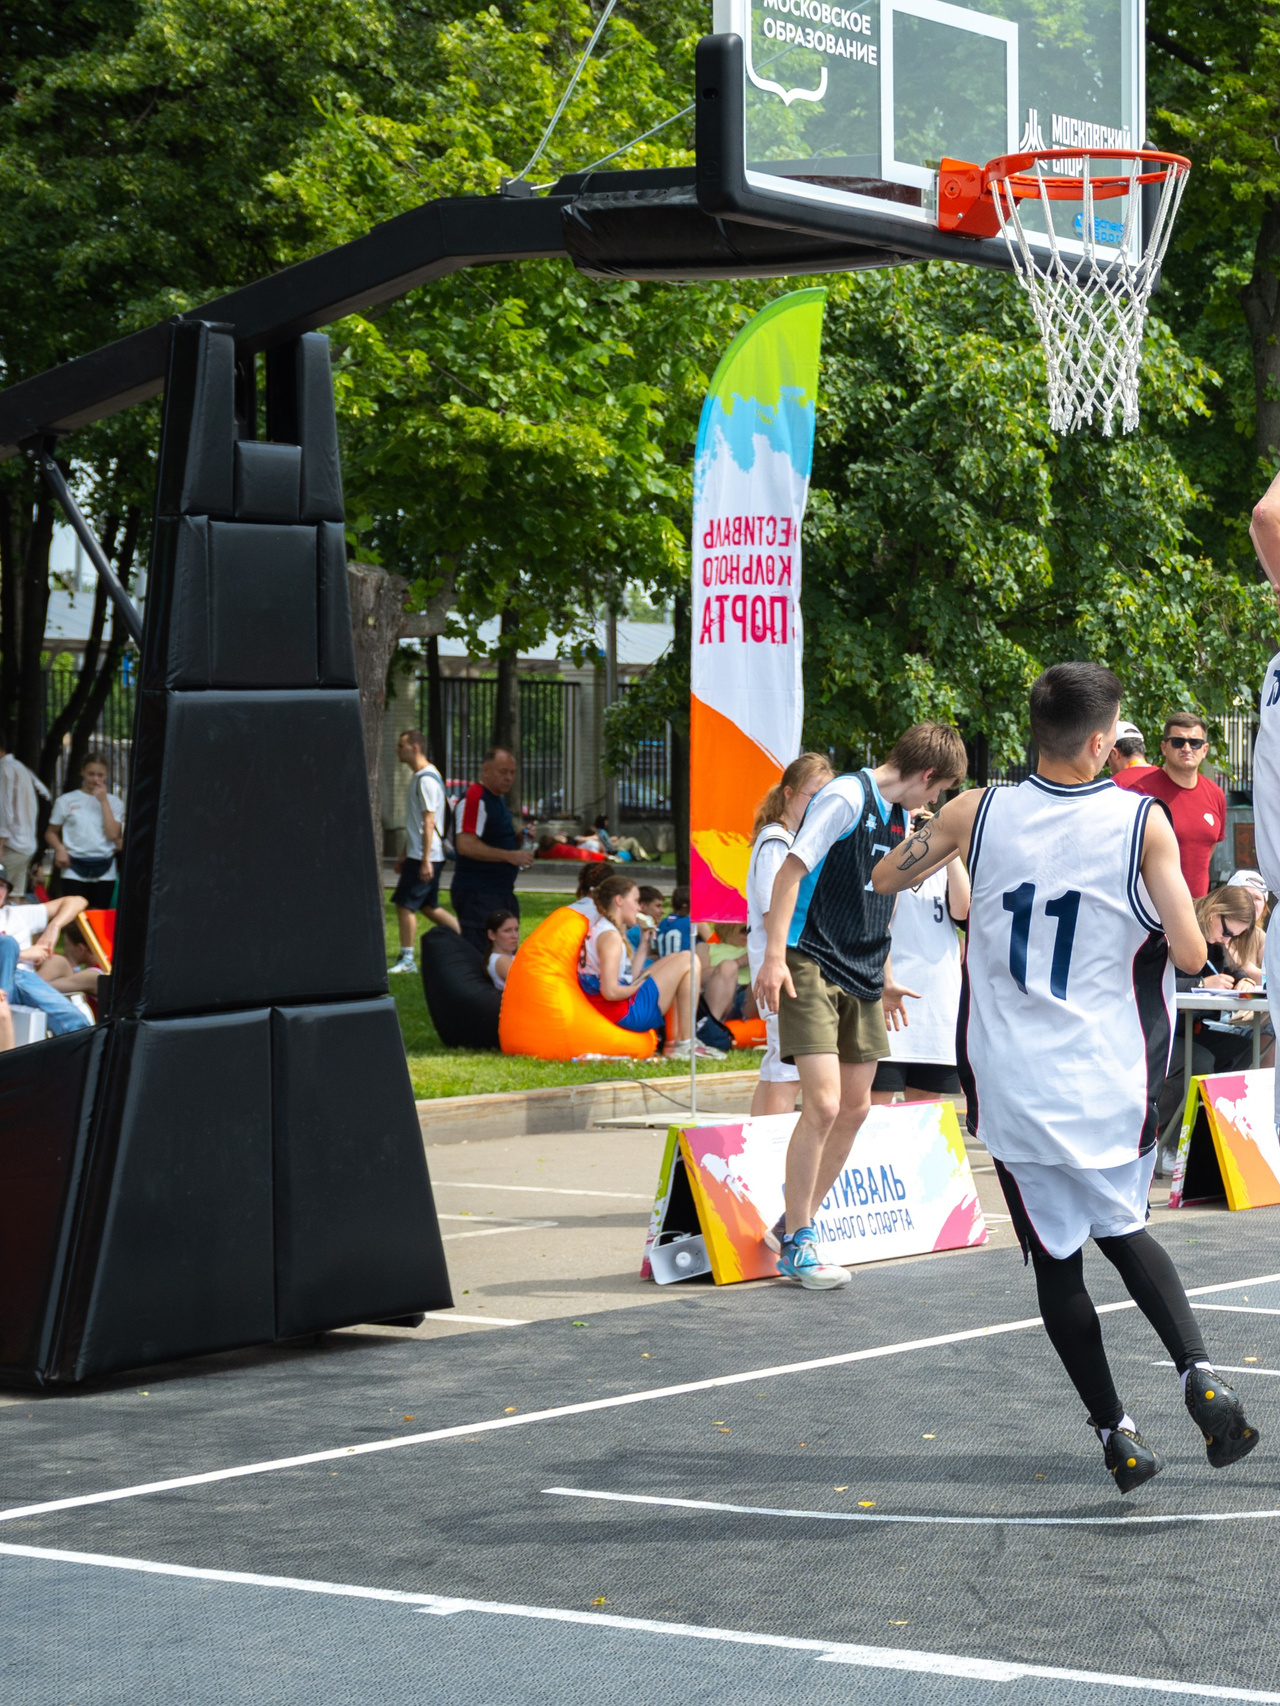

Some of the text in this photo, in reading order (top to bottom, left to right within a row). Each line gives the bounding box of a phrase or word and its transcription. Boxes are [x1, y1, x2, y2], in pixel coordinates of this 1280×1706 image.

[763, 17, 878, 66] ОБРАЗОВАНИЕ
[1052, 113, 1131, 150] МОСКОВСКИЙ
[1052, 144, 1084, 177] СПОР
[1003, 882, 1081, 1001] 11
[867, 1208, 915, 1236] СПОРТА
